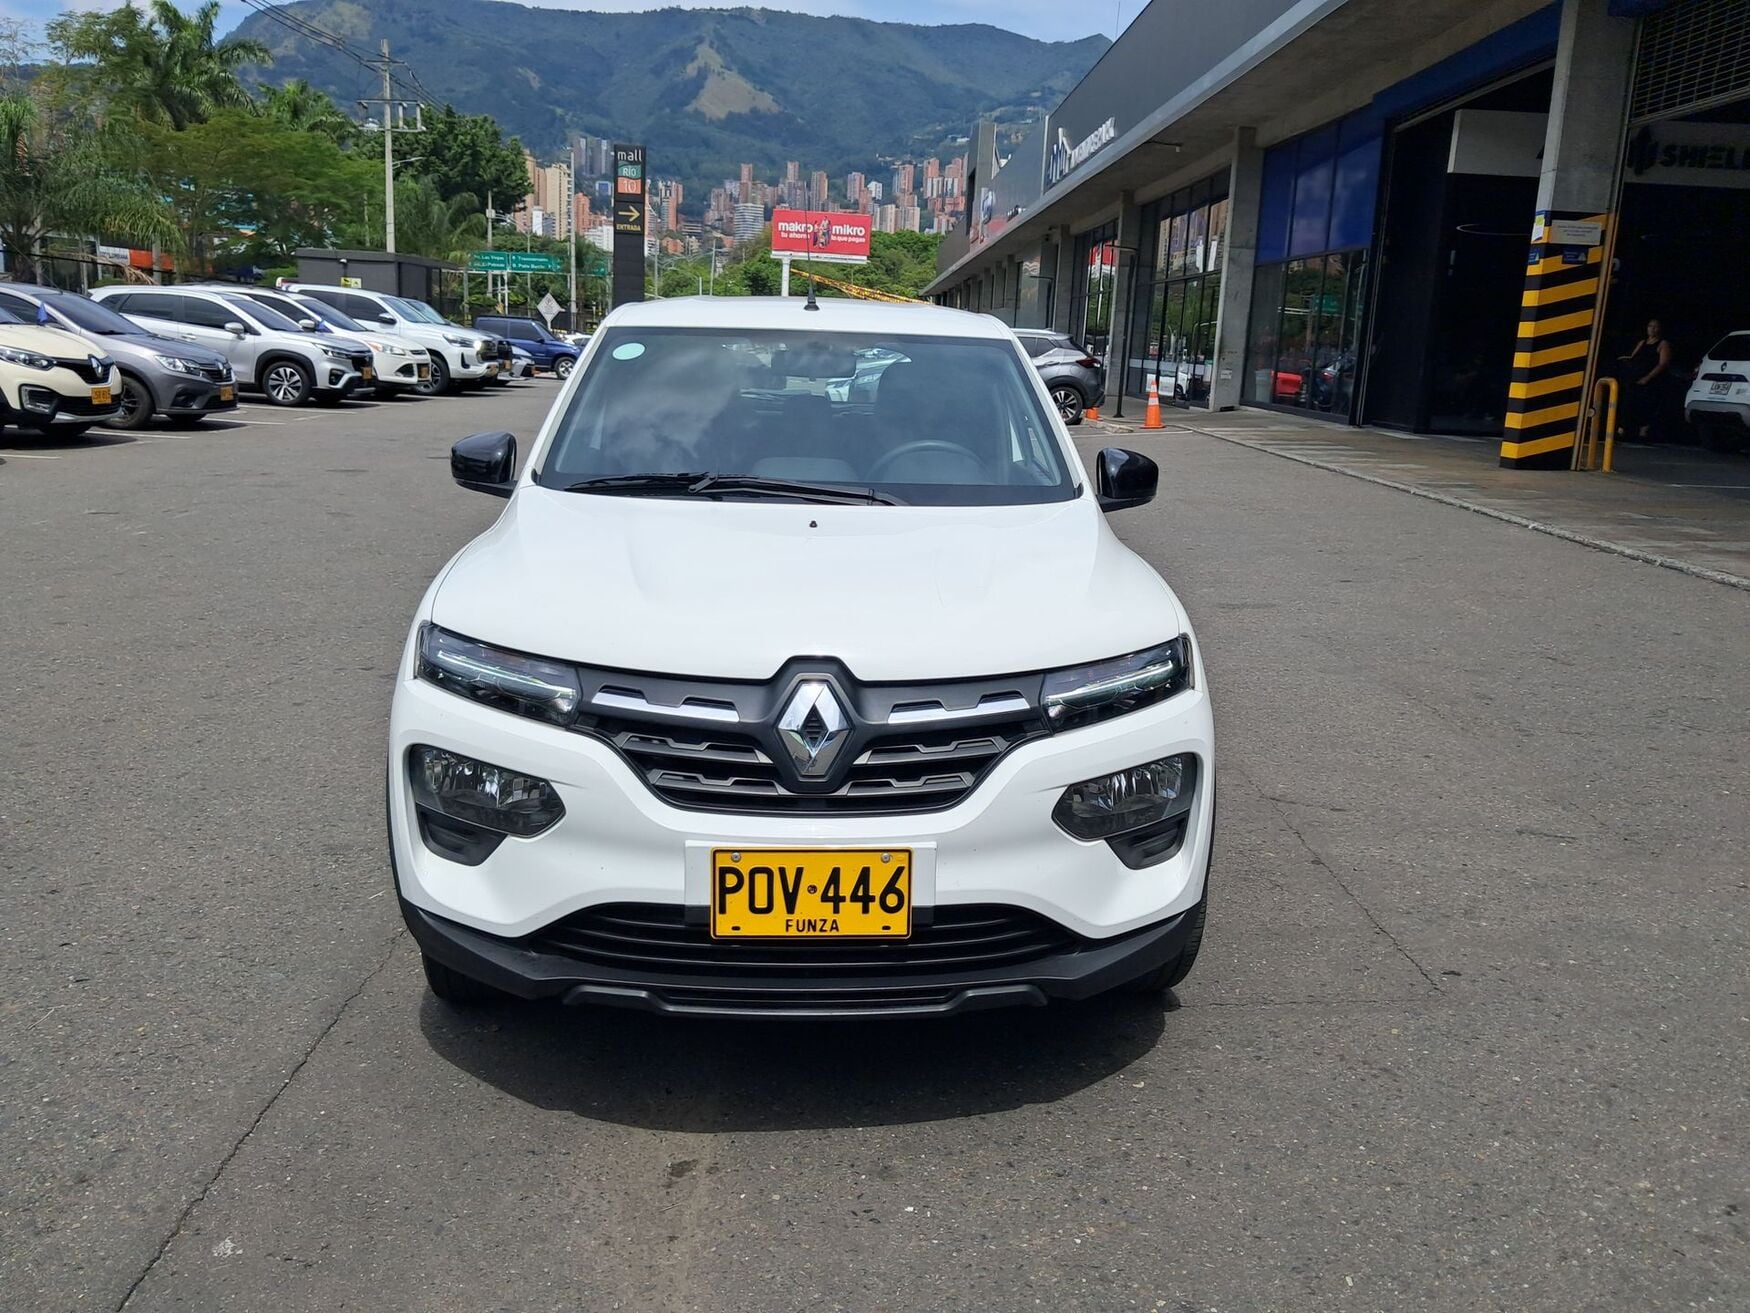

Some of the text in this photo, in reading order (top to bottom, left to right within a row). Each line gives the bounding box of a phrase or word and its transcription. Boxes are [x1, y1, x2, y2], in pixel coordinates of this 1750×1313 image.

[617, 149, 642, 162] mall
[623, 179, 637, 192] 10
[616, 223, 641, 231] ENTRADA
[778, 221, 813, 233] makro
[832, 224, 865, 236] mikro
[785, 918, 840, 933] FUNZA
